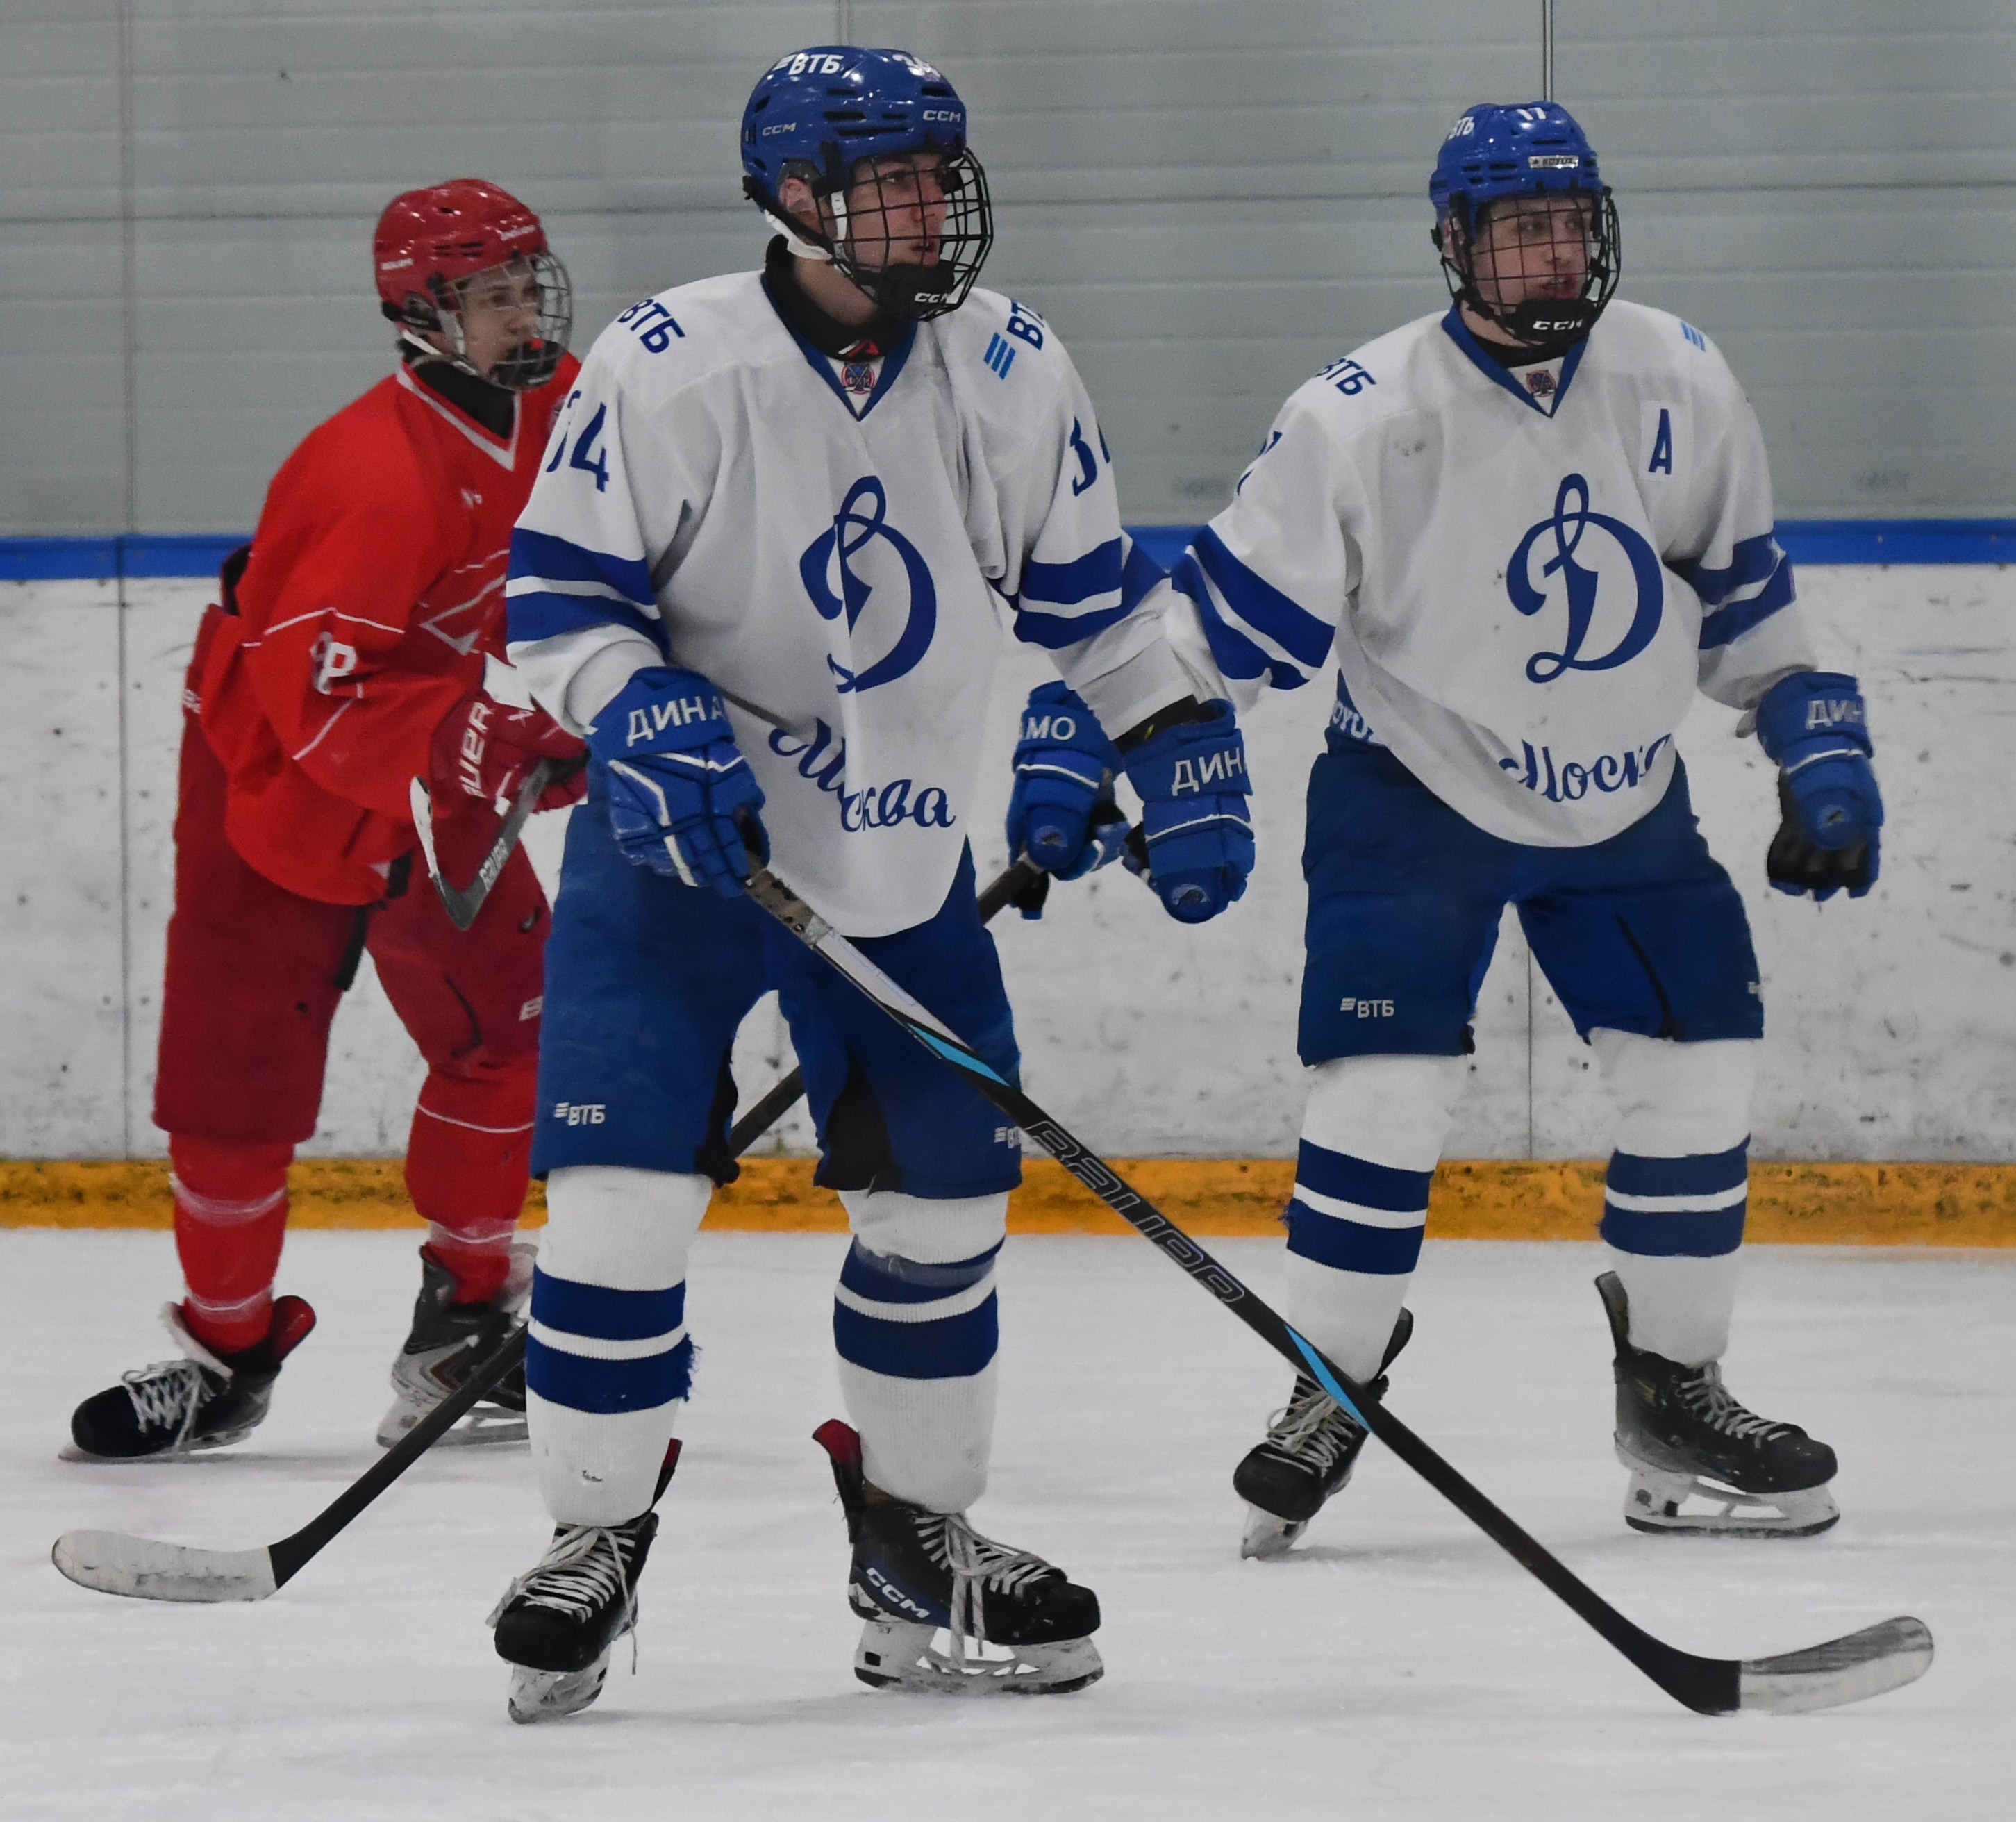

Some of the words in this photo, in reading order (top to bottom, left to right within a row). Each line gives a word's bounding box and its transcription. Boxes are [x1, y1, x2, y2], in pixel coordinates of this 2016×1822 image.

[788, 53, 845, 75] ВТБ
[923, 109, 962, 123] CCM
[762, 122, 797, 136] CCM
[617, 298, 686, 354] ВТБ
[1532, 320, 1583, 331] CCM
[1069, 415, 1111, 497] 3
[1357, 1000, 1395, 1019] ВТБ
[567, 1104, 606, 1126] ВТБ
[866, 1566, 931, 1619] CCM
